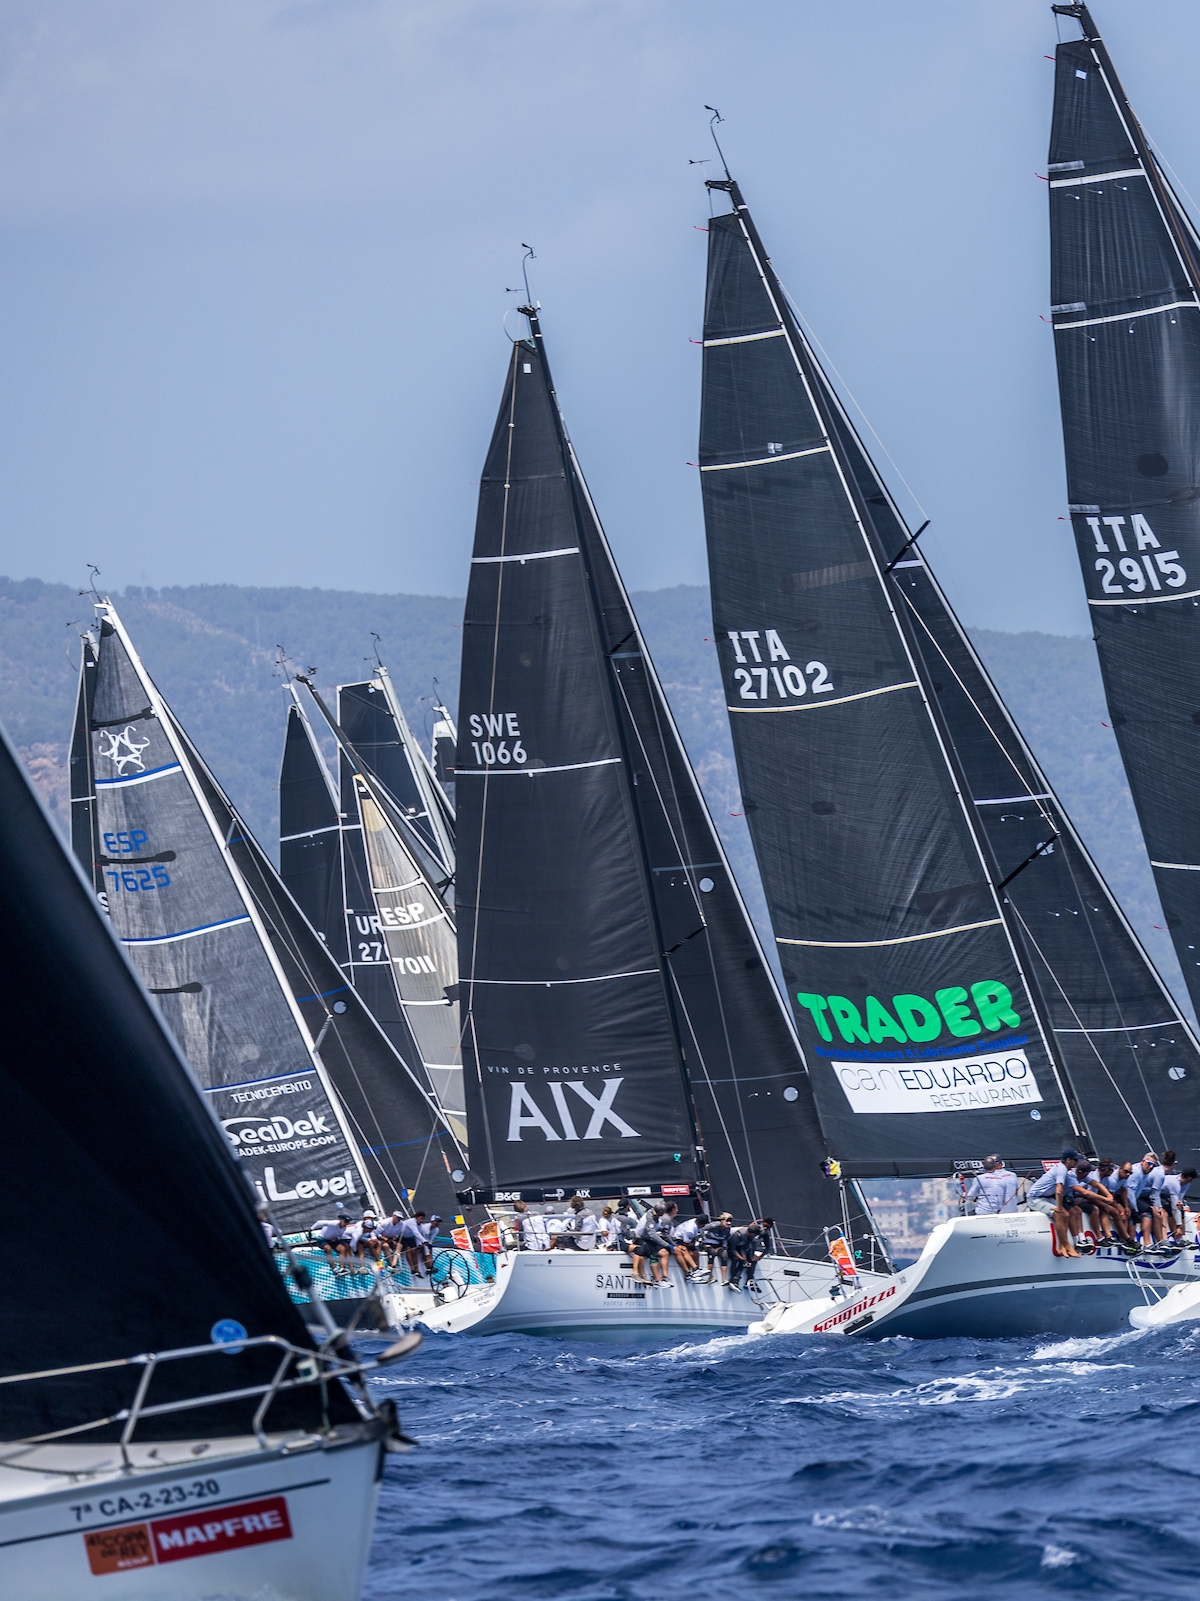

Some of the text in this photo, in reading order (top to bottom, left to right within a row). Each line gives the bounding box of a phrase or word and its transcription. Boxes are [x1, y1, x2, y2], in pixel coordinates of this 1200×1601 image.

[1085, 513, 1162, 553] ITA
[1094, 550, 1187, 594] 2915
[727, 629, 791, 664] ITA
[734, 660, 835, 700] 27102
[469, 712, 521, 738] SWE
[471, 740, 528, 765] 1066
[103, 829, 148, 854] ESP
[106, 865, 171, 892] 7625
[379, 902, 425, 925] ESP
[391, 955, 437, 975] 7011
[797, 979, 1022, 1044] TRADER
[905, 1047, 915, 1059] &
[914, 1042, 977, 1059] Lubricants
[977, 1034, 1029, 1052] Supplier
[487, 1062, 622, 1075] VIN DE PROVENCE
[230, 1079, 313, 1104] TECNOCEMENTO
[930, 1083, 1032, 1108] RESTAURANT
[507, 1077, 642, 1142] AIX
[495, 1191, 522, 1202] B&G
[575, 1189, 591, 1198] AIX
[99, 1478, 221, 1517] CA-2-23-20
[157, 1509, 284, 1551] MAPFRE
